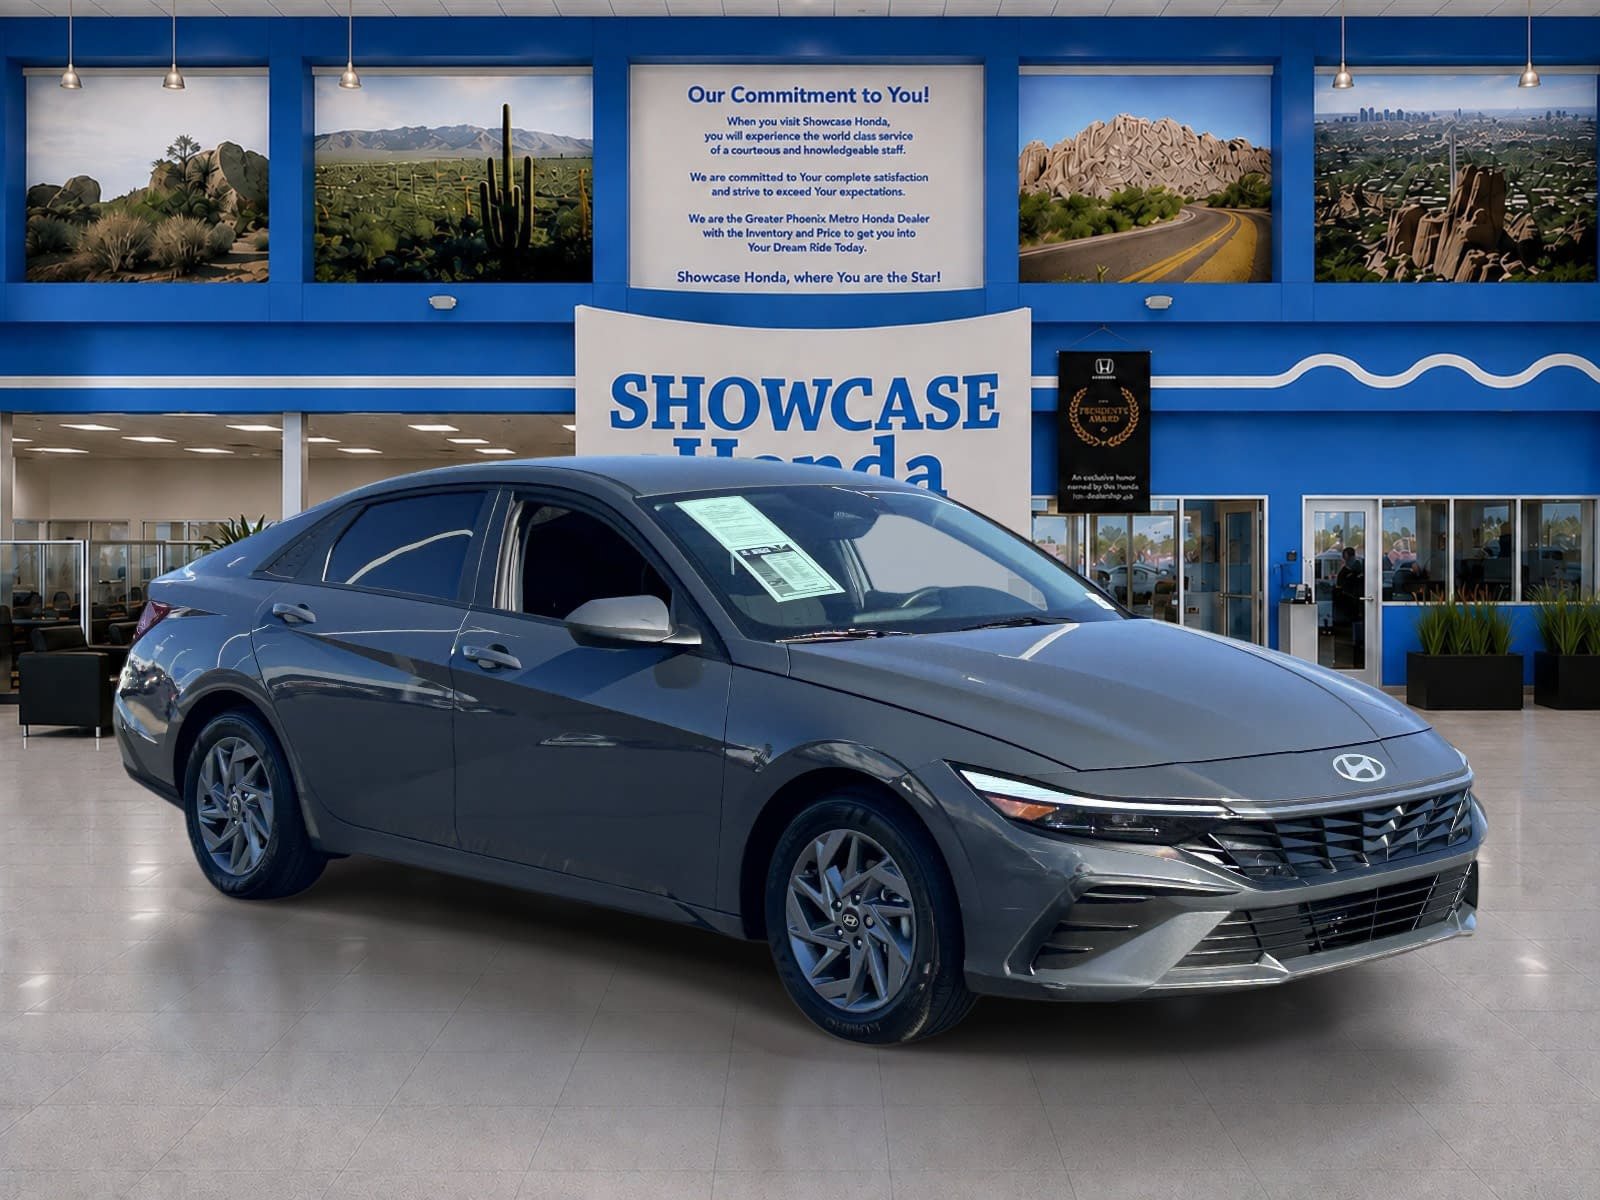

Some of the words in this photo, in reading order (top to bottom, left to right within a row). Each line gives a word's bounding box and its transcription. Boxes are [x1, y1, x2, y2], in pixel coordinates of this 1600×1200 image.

[687, 85, 726, 104] Our
[730, 85, 857, 104] Commitment
[861, 87, 883, 104] to
[886, 85, 930, 104] You!
[726, 116, 757, 127] When
[758, 118, 778, 129] you
[779, 116, 801, 127] visit
[802, 116, 853, 127] Showcase
[854, 116, 891, 128] Honda,
[704, 132, 724, 144] you
[725, 130, 744, 141] will
[745, 130, 801, 144] experience
[802, 130, 821, 141] the
[821, 130, 851, 141] world
[852, 130, 877, 141] class
[878, 130, 914, 142] service
[709, 144, 722, 155] of
[722, 147, 730, 155] a
[730, 146, 782, 156] courteous
[782, 144, 802, 155] and
[881, 144, 906, 155] staff.
[689, 172, 708, 183] We
[709, 174, 727, 182] are
[728, 171, 784, 183] committed
[785, 173, 798, 183] to
[799, 172, 823, 182] Your
[824, 172, 872, 185] complete
[873, 171, 929, 183] satisfaction
[711, 186, 731, 197] and
[732, 186, 761, 197] strive
[762, 187, 774, 197] to
[775, 186, 812, 197] exceed
[814, 186, 838, 197] Your
[839, 186, 906, 200] expectations.
[688, 213, 706, 224] We
[707, 215, 725, 224] are
[725, 213, 743, 224] the
[744, 213, 785, 224] Greater
[785, 213, 827, 224] Phoenix
[828, 213, 860, 224] Metro
[861, 213, 895, 224] Honda
[897, 213, 931, 224] Dealer
[702, 227, 725, 238] with
[726, 227, 744, 238] the
[745, 227, 794, 241] Inventory
[795, 227, 815, 239] and
[816, 227, 842, 239] Price
[843, 229, 855, 239] to
[856, 229, 875, 241] get
[875, 230, 895, 241] you
[896, 227, 917, 238] into
[747, 242, 772, 253] Your
[772, 242, 808, 253] Dream
[809, 242, 833, 253] Ride
[833, 242, 868, 255] Today.
[677, 270, 741, 284] Showcase
[744, 270, 790, 285] Honda,
[793, 270, 834, 284] where
[836, 271, 861, 284] You
[863, 274, 884, 284] are
[886, 270, 908, 284] the
[911, 271, 941, 284] Star!
[609, 372, 1001, 432] SHOWCASE
